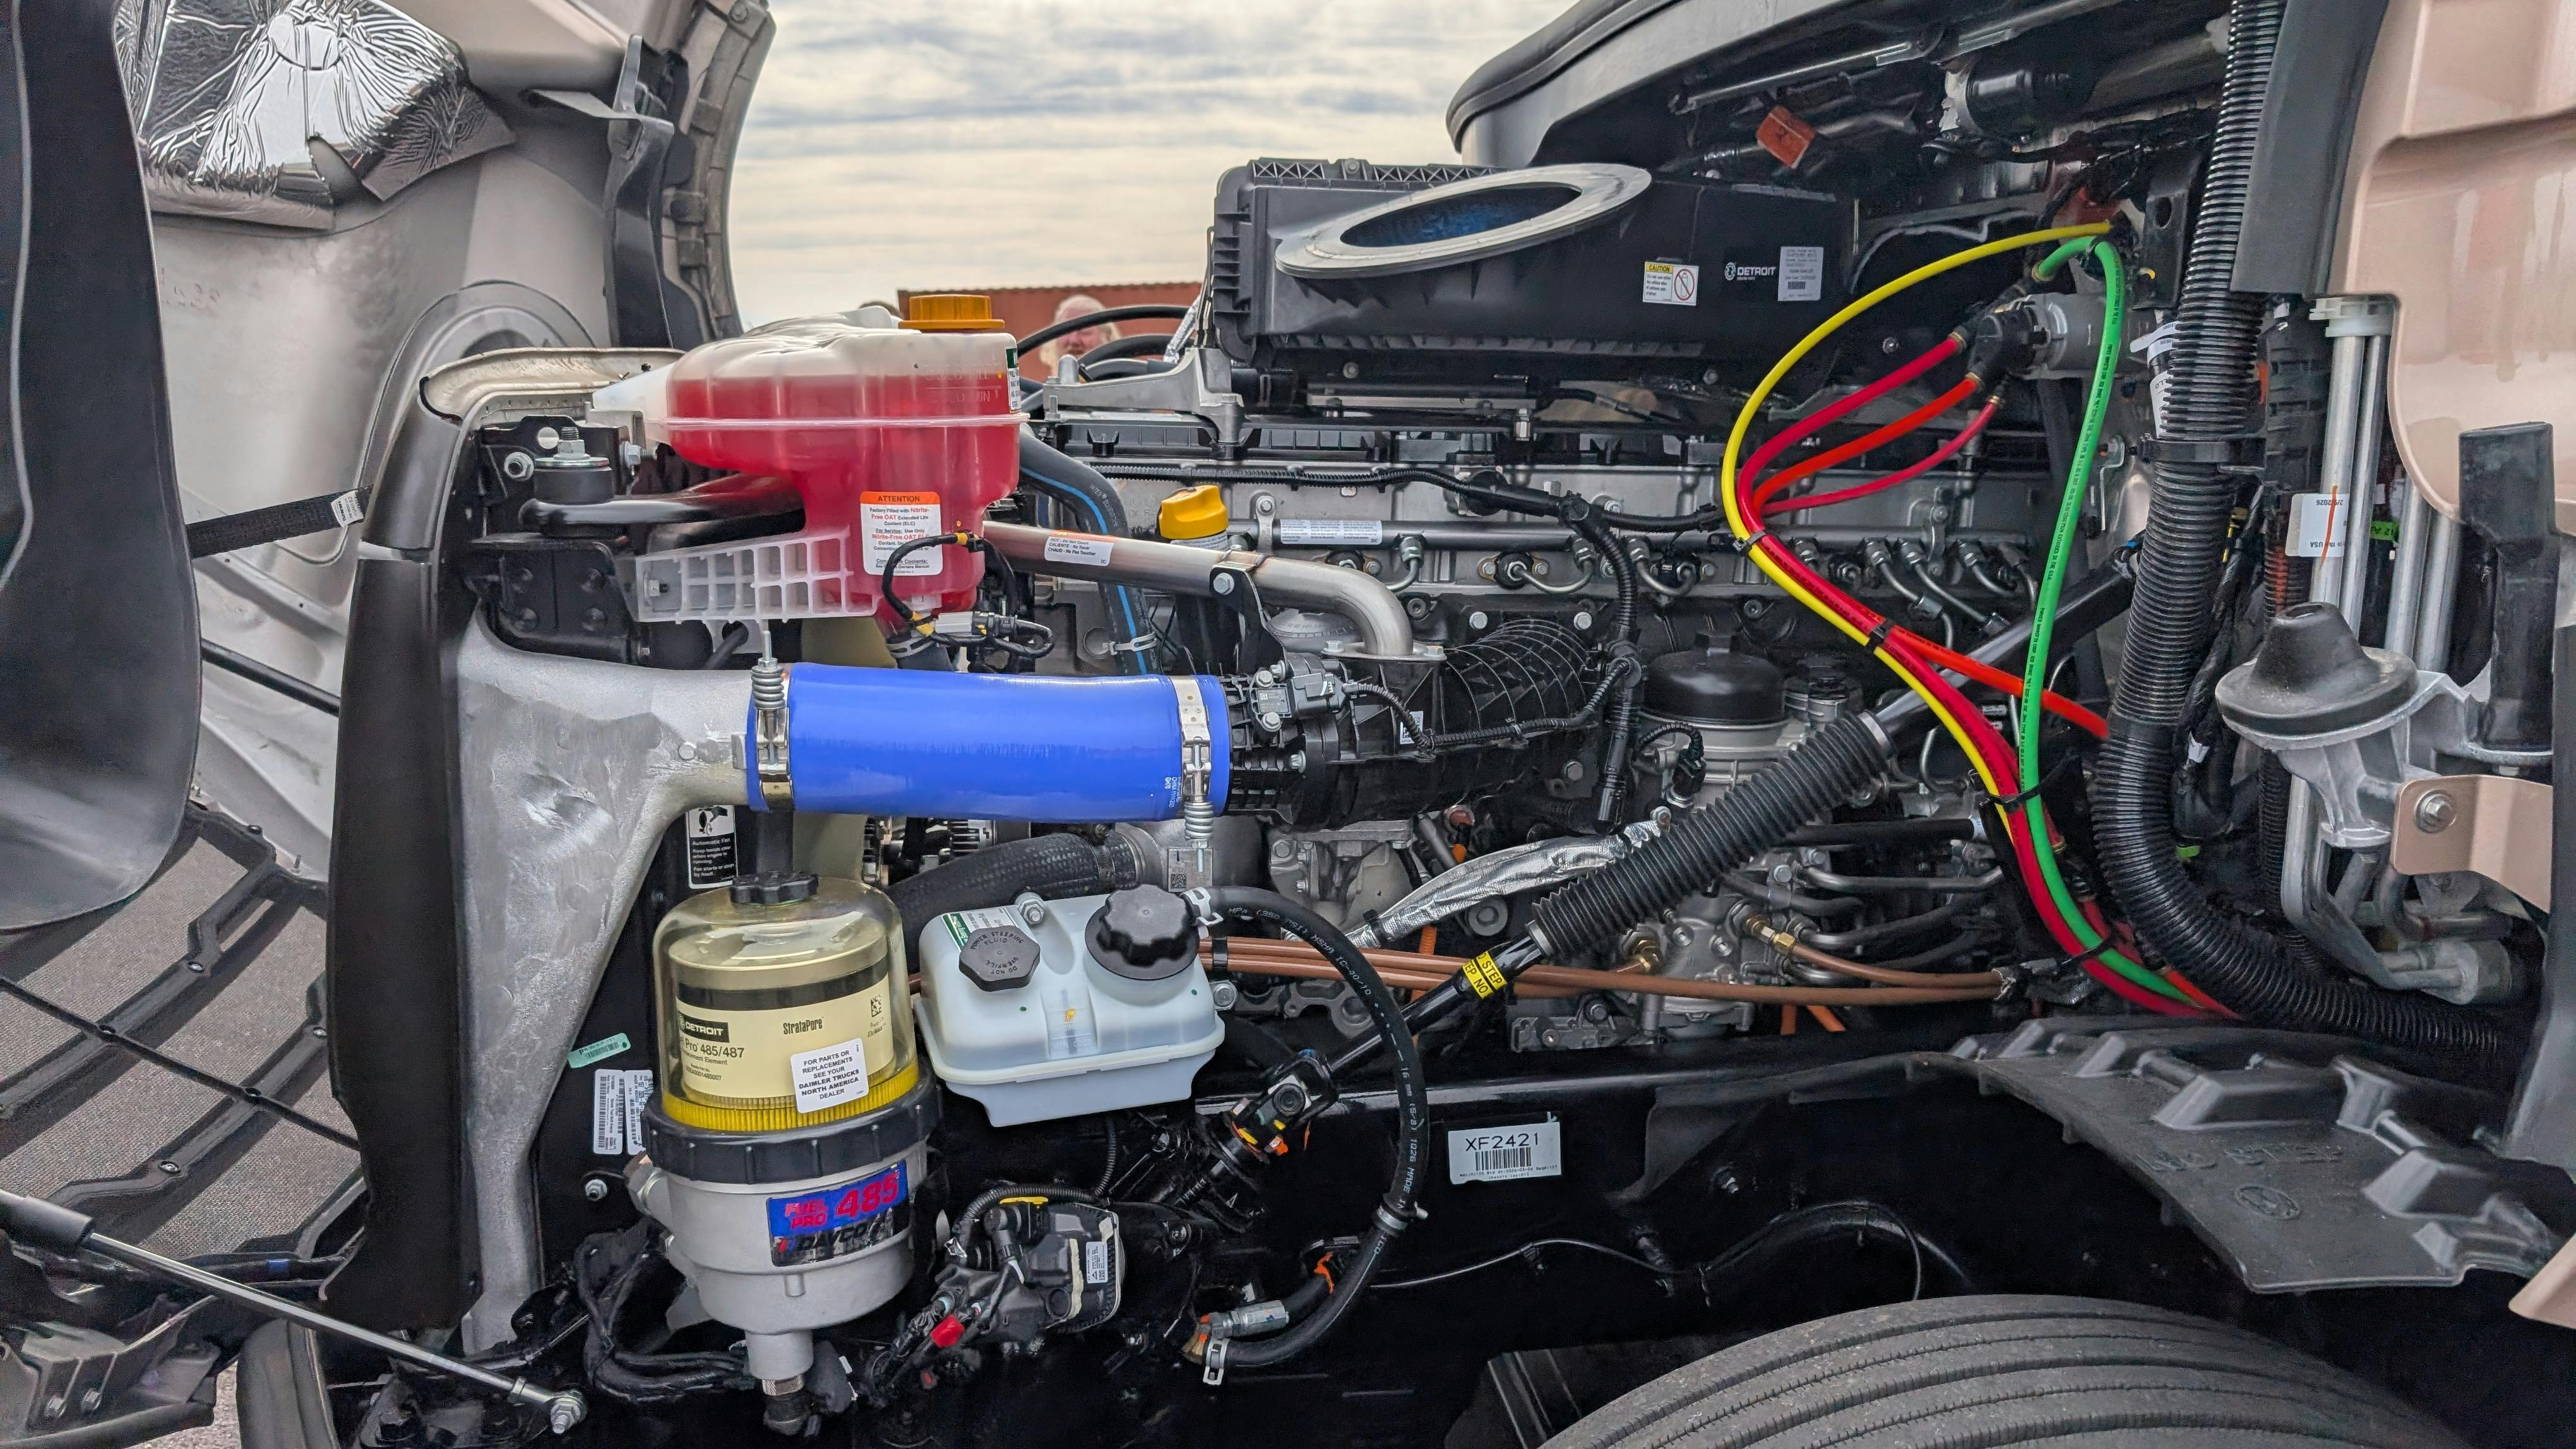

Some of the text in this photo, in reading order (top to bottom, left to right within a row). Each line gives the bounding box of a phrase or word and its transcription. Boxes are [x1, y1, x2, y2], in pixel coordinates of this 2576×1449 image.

[1737, 266, 1776, 276] DETROIT
[970, 931, 1024, 950] POWER STEERING
[1311, 934, 1335, 954] MSHA
[986, 957, 1018, 969] OVERFILL
[1482, 961, 1502, 983] STEP
[1474, 979, 1488, 993] NO
[685, 1021, 724, 1035] DETROIT
[783, 1018, 823, 1035] StrataPore
[685, 1037, 698, 1052] Pro
[701, 1044, 745, 1058] 485/487
[705, 1057, 728, 1065] Element
[802, 1056, 852, 1073] REPLACEMENTS
[819, 1053, 839, 1063] PARTS
[799, 1069, 859, 1089] DAIMLER TRUCKS
[828, 1066, 845, 1075] YOUR
[1400, 1067, 1410, 1078] 16
[801, 1076, 859, 1096] NORTH AMERICA
[820, 1088, 845, 1099] DEALER
[1405, 1083, 1412, 1097] mm
[1409, 1103, 1417, 1130] (5/8)
[1465, 1133, 1538, 1152] XF2421
[1403, 1167, 1415, 1193] MADE
[835, 1169, 900, 1217] 485
[785, 1198, 828, 1217] FUEL
[791, 1212, 828, 1229] PRO
